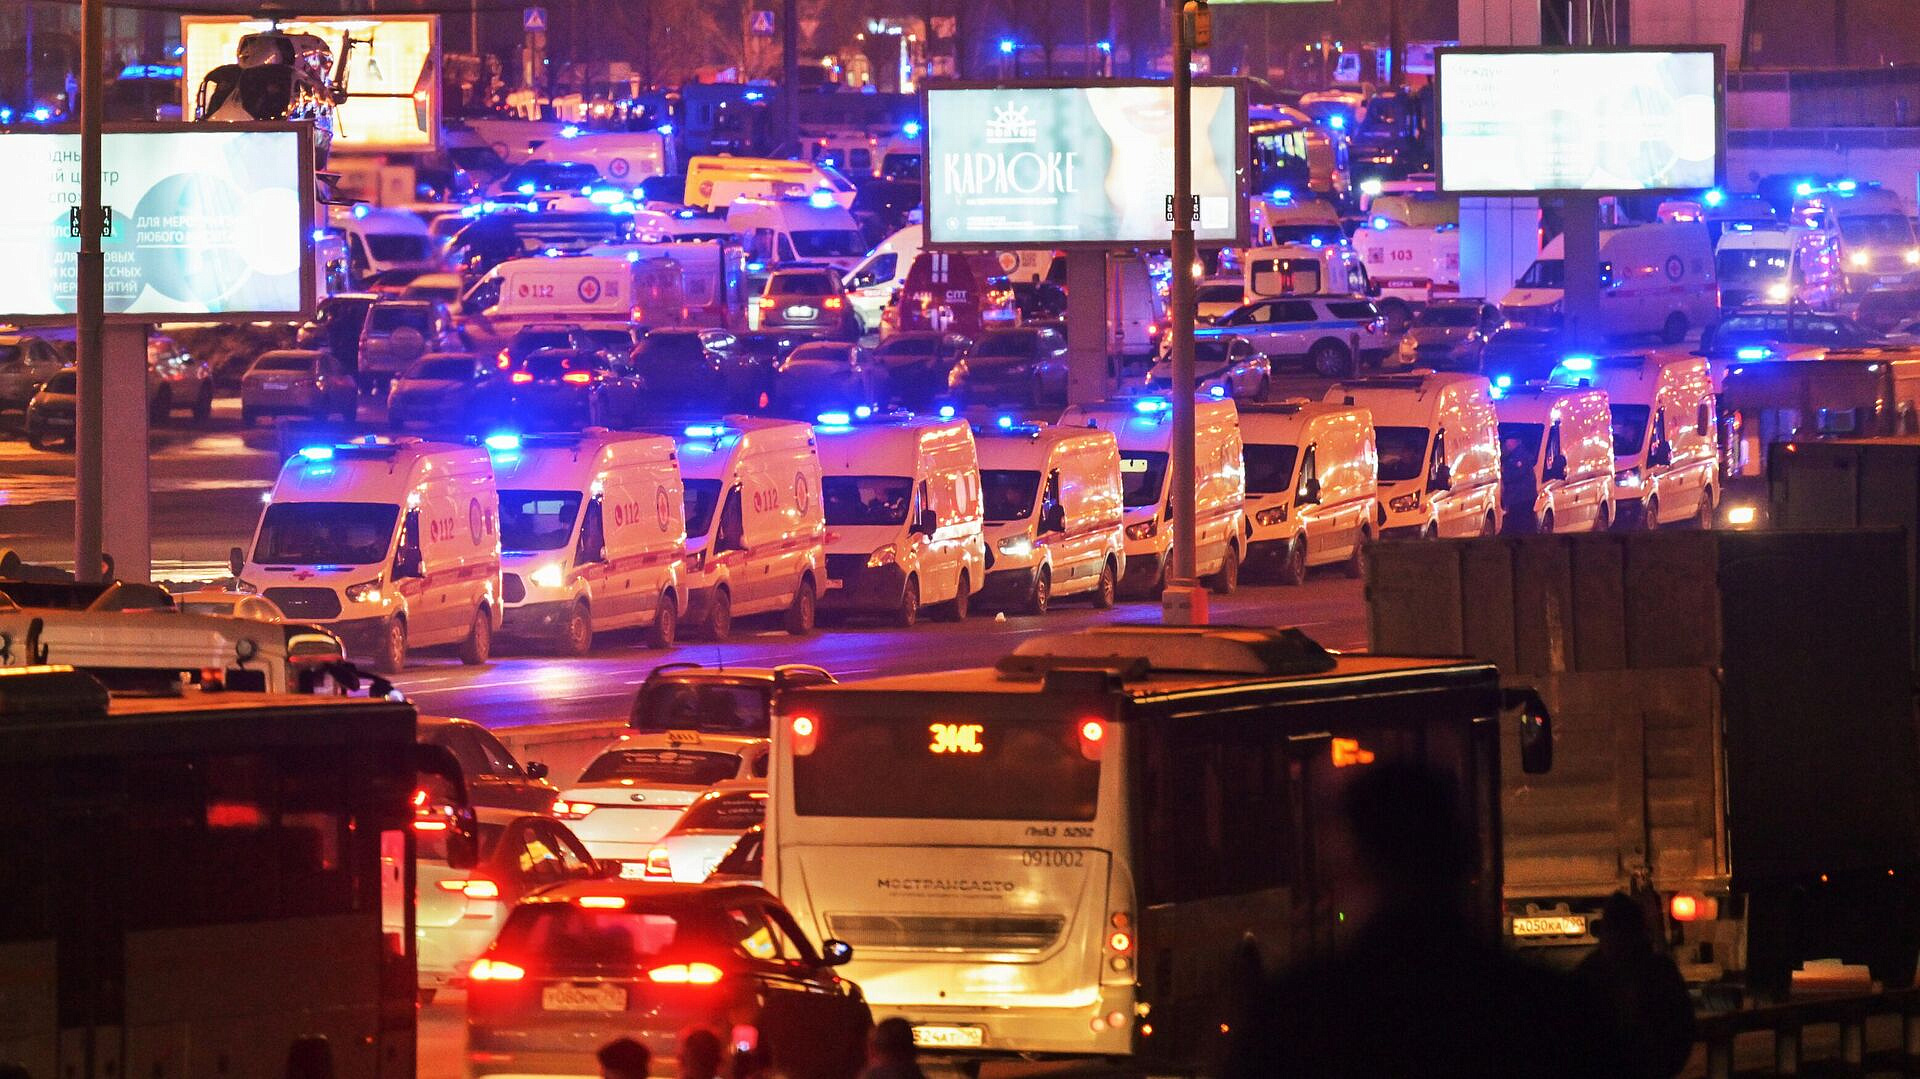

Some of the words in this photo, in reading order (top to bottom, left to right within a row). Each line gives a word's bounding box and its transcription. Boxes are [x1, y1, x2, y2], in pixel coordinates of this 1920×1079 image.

[944, 151, 1079, 194] КАРАОКЕ
[136, 216, 161, 228] ДЛЯ
[136, 231, 184, 243] ЛЮБОГО
[1391, 249, 1413, 261] 103
[532, 285, 554, 297] 112
[763, 490, 779, 511] 112
[625, 502, 640, 524] 112
[440, 518, 454, 541] 112
[1022, 850, 1084, 867] 091002
